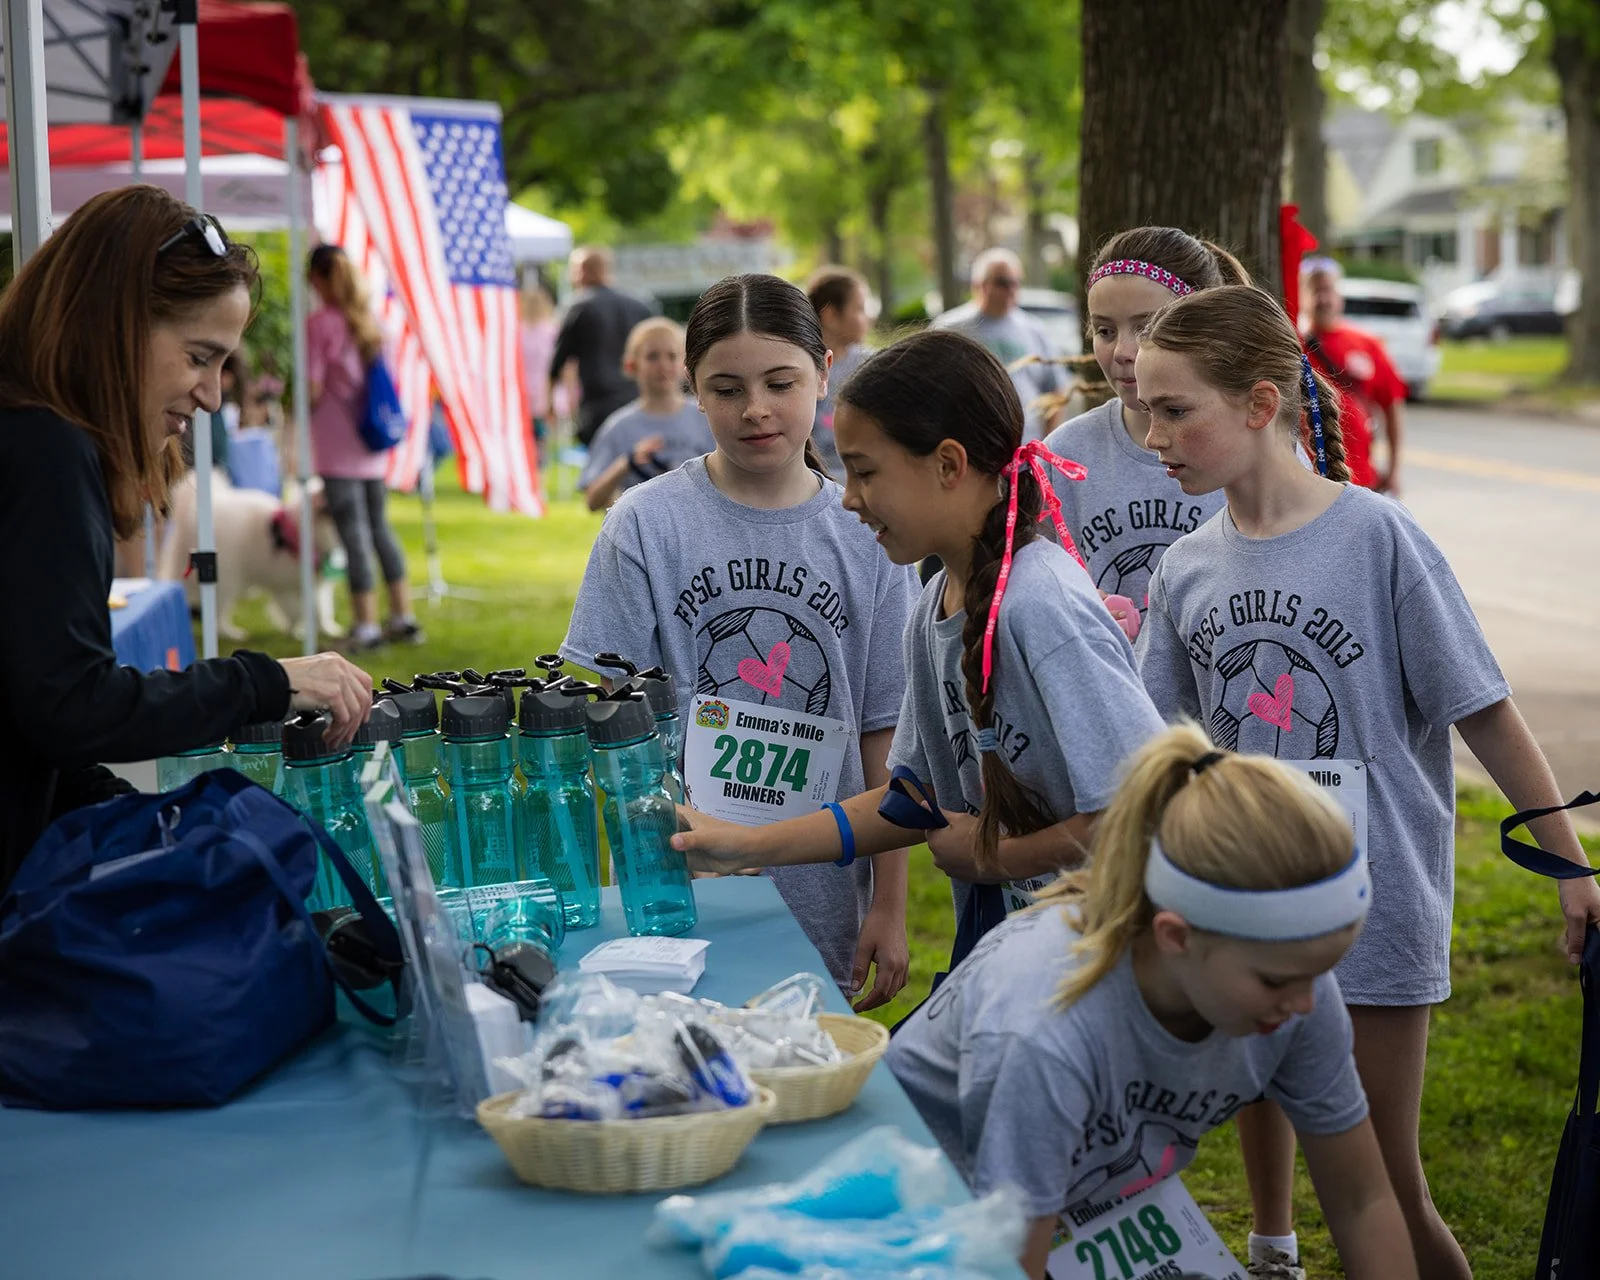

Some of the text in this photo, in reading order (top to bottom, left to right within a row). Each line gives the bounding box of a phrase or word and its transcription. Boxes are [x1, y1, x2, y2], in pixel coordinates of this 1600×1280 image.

[1128, 499, 1202, 533] GIRLS
[673, 566, 722, 630] FPSC
[727, 558, 808, 598] GIRLS
[1188, 589, 1365, 671] FPSC GIRLS 2013
[735, 711, 825, 742] Emma's Mile
[709, 734, 811, 793] 2874
[1309, 771, 1342, 787] Mile
[723, 781, 786, 806] RUNNERS
[1125, 1080, 1217, 1123] GIRLS
[1075, 1203, 1182, 1280] 2748
